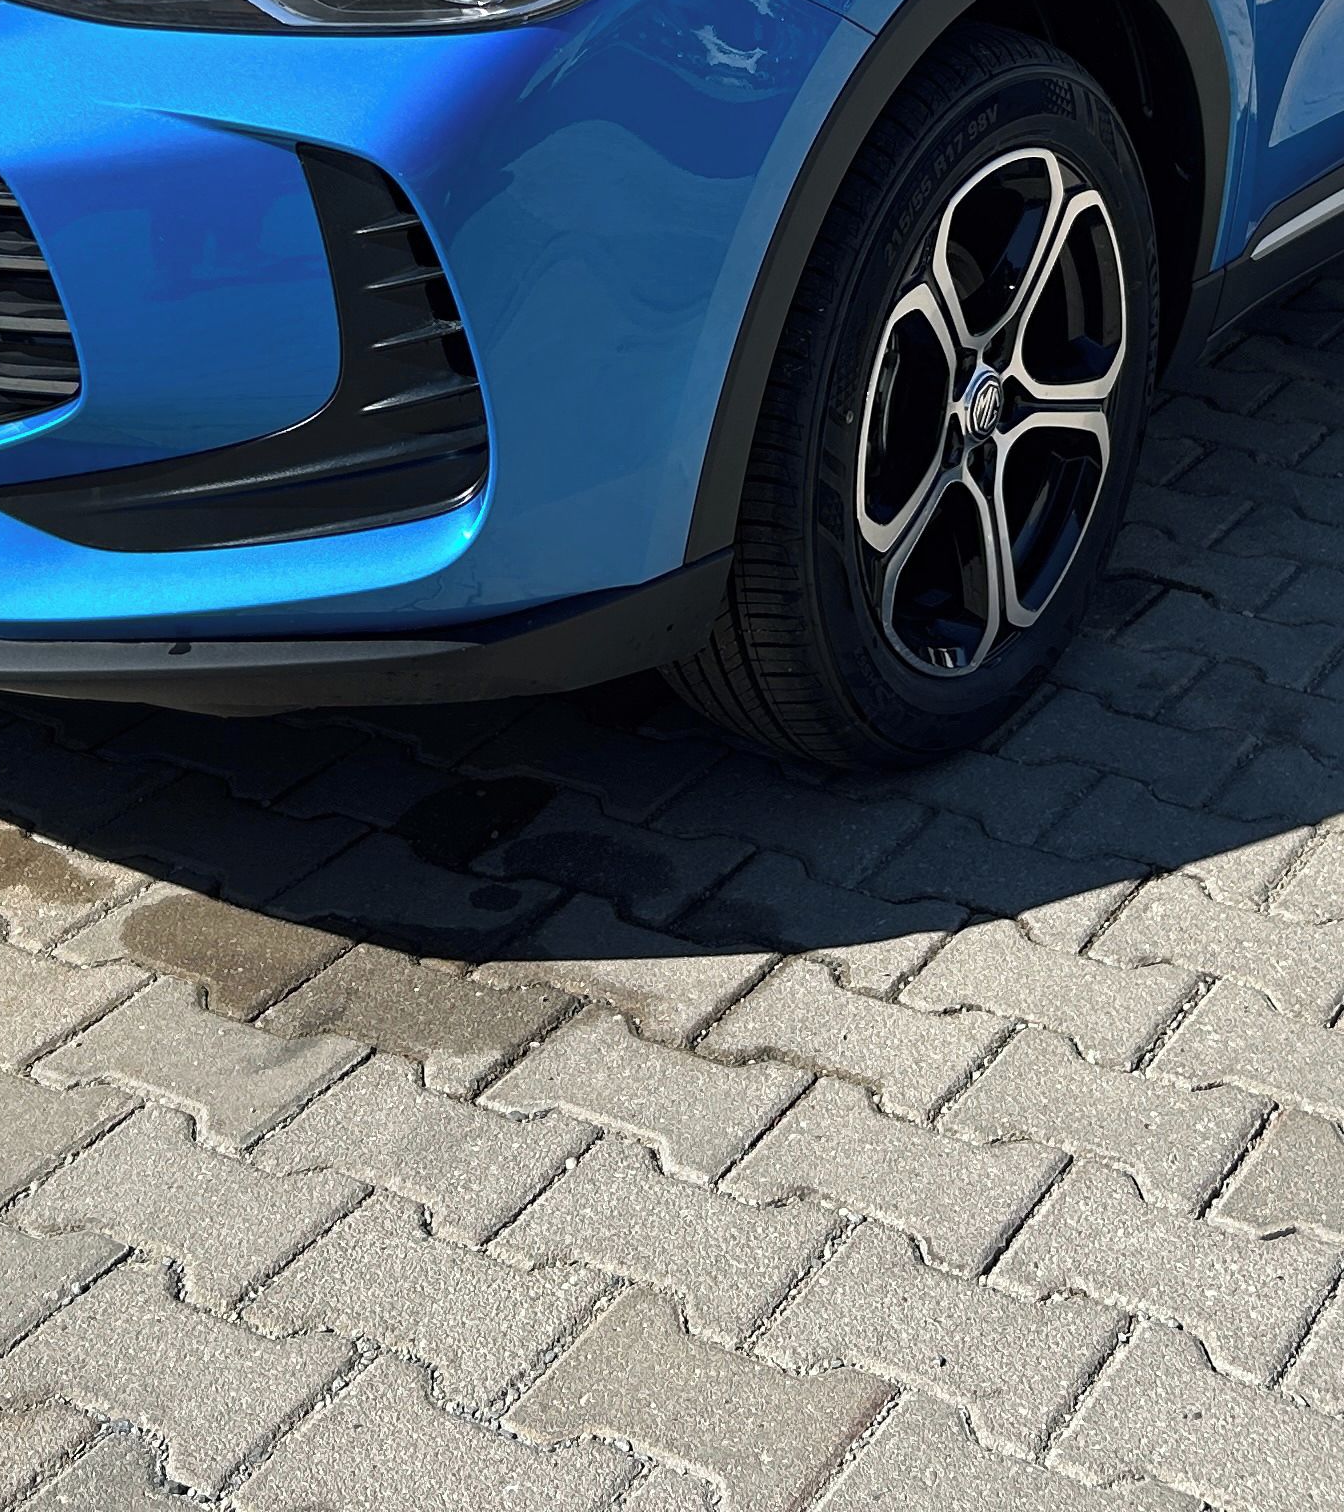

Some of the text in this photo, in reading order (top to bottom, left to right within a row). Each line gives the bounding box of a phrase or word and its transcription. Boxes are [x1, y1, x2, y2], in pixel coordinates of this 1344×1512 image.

[933, 132, 965, 179] R17
[967, 103, 999, 141] 98V
[976, 385, 1000, 429] MG
